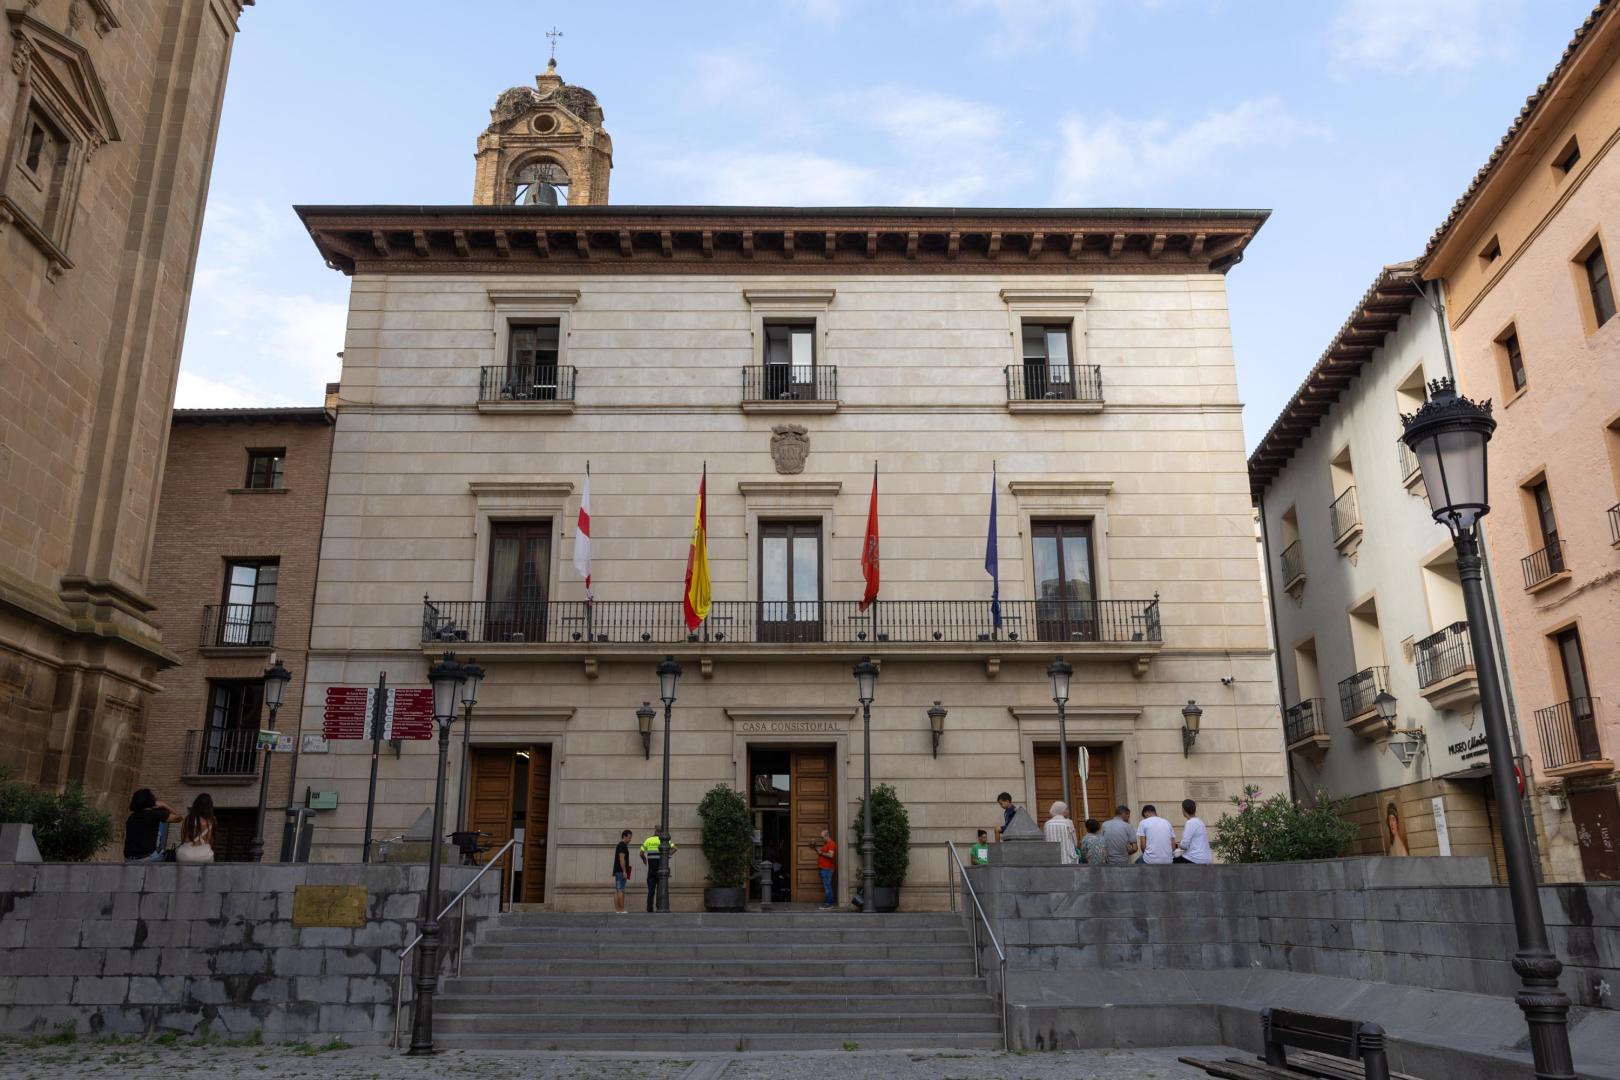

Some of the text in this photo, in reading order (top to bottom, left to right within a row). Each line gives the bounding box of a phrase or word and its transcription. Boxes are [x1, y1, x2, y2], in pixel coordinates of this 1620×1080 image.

[743, 722, 840, 731] CASA CONSISTORIAL
[1448, 741, 1467, 755] MUSEO
